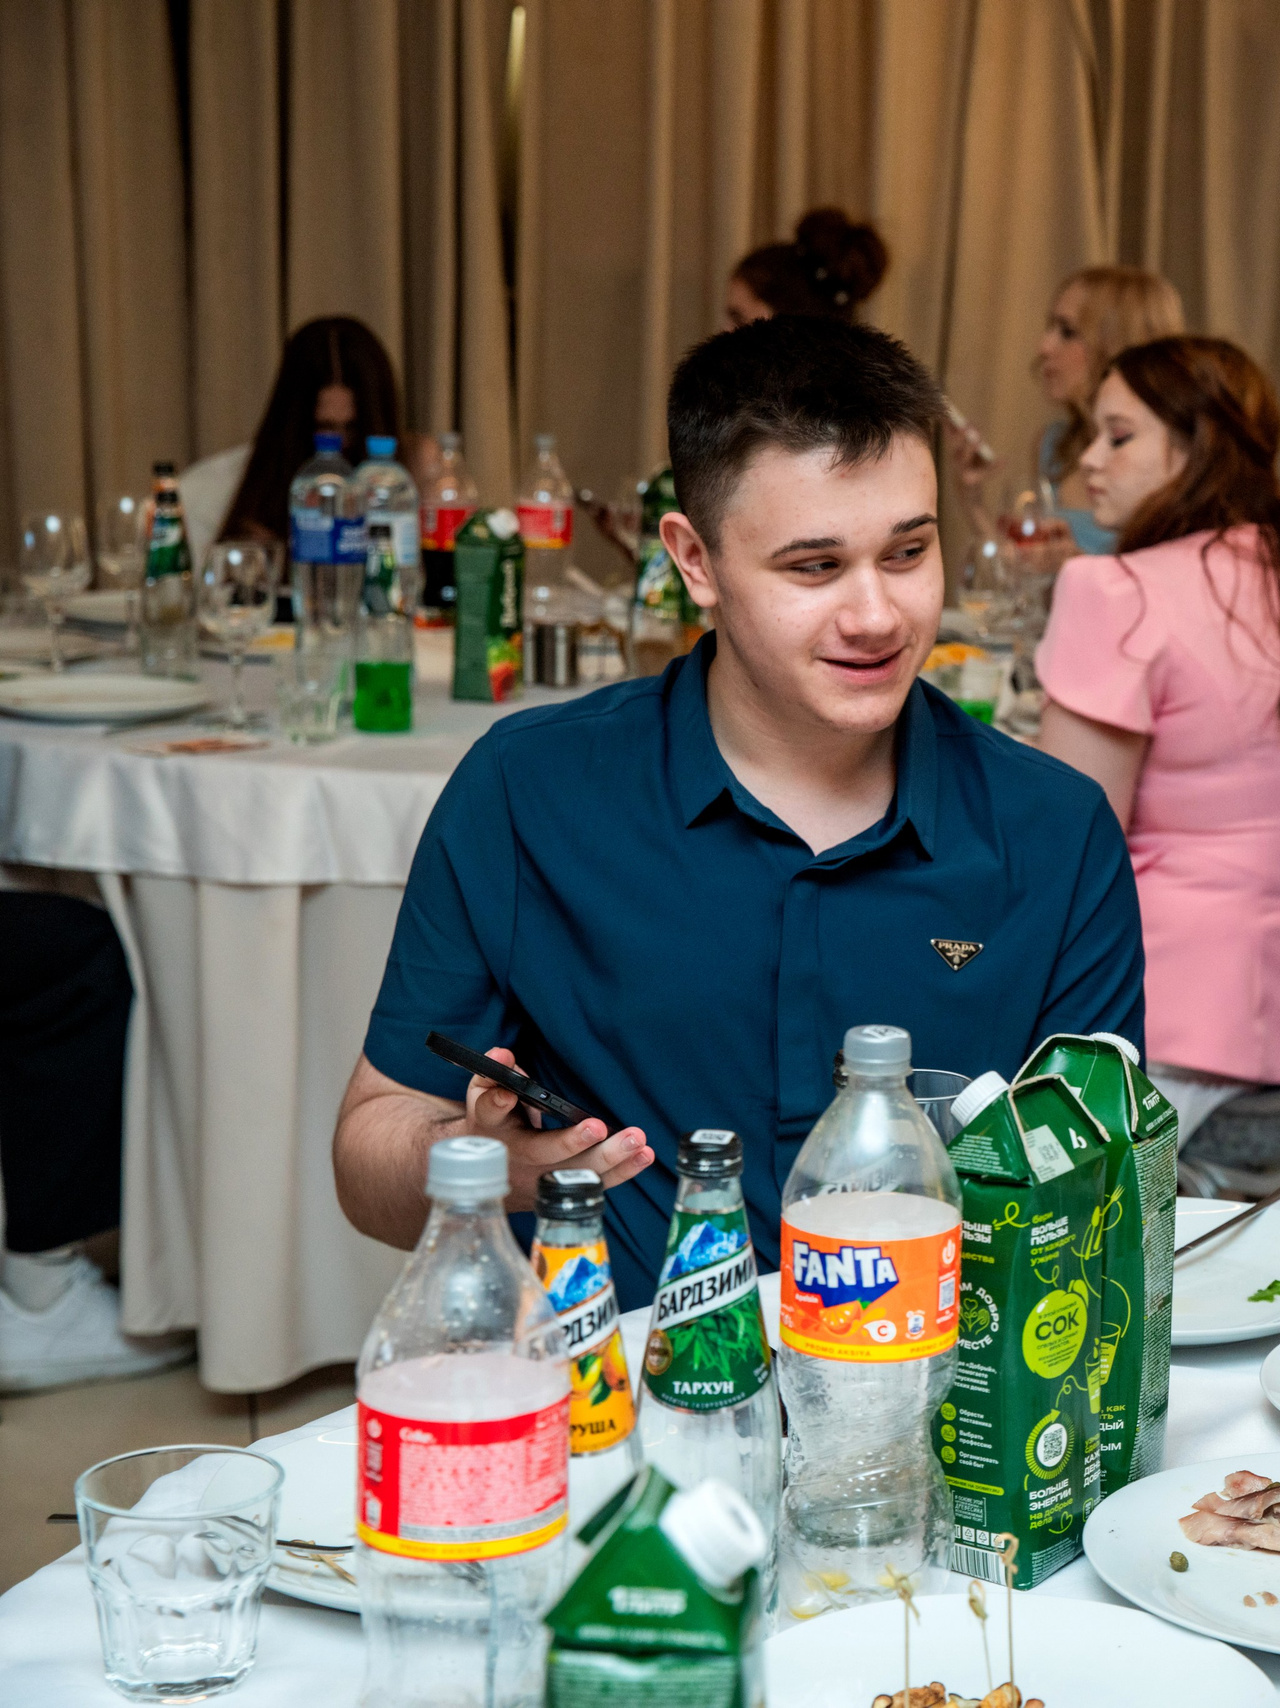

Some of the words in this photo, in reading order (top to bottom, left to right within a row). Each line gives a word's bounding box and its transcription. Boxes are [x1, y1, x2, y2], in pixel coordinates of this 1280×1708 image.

[938, 942, 976, 952] PRADA
[962, 1220, 992, 1234] ЛЬШЕ
[1031, 1215, 1068, 1237] БОЛЬШЕ
[961, 1230, 992, 1244] ЛЬЗЫ
[1031, 1225, 1068, 1246] ПОЛЬЗЫ
[1030, 1247, 1043, 1256] от
[793, 1241, 898, 1289] FANTA
[975, 1287, 999, 1333] ДОБРО
[1035, 1307, 1080, 1341] СОК
[957, 1334, 993, 1350] МЕСТЕ
[805, 1342, 835, 1354] PROMO
[838, 1347, 871, 1357] AKSIYA
[672, 1381, 734, 1395] ТАРХУН
[959, 1408, 984, 1419] Обрести
[1106, 1404, 1126, 1412] как
[570, 1419, 617, 1437] РУША
[959, 1416, 992, 1428] наставника
[1099, 1419, 1124, 1432] ДЫЙ
[959, 1429, 984, 1441] Выбрать
[1029, 1478, 1069, 1500] БОЛЬШЕ
[1029, 1488, 1072, 1511] ЭНЕРГИИ
[1029, 1512, 1043, 1521] на
[1044, 1497, 1073, 1518] добрые
[1029, 1516, 1053, 1530] дела
